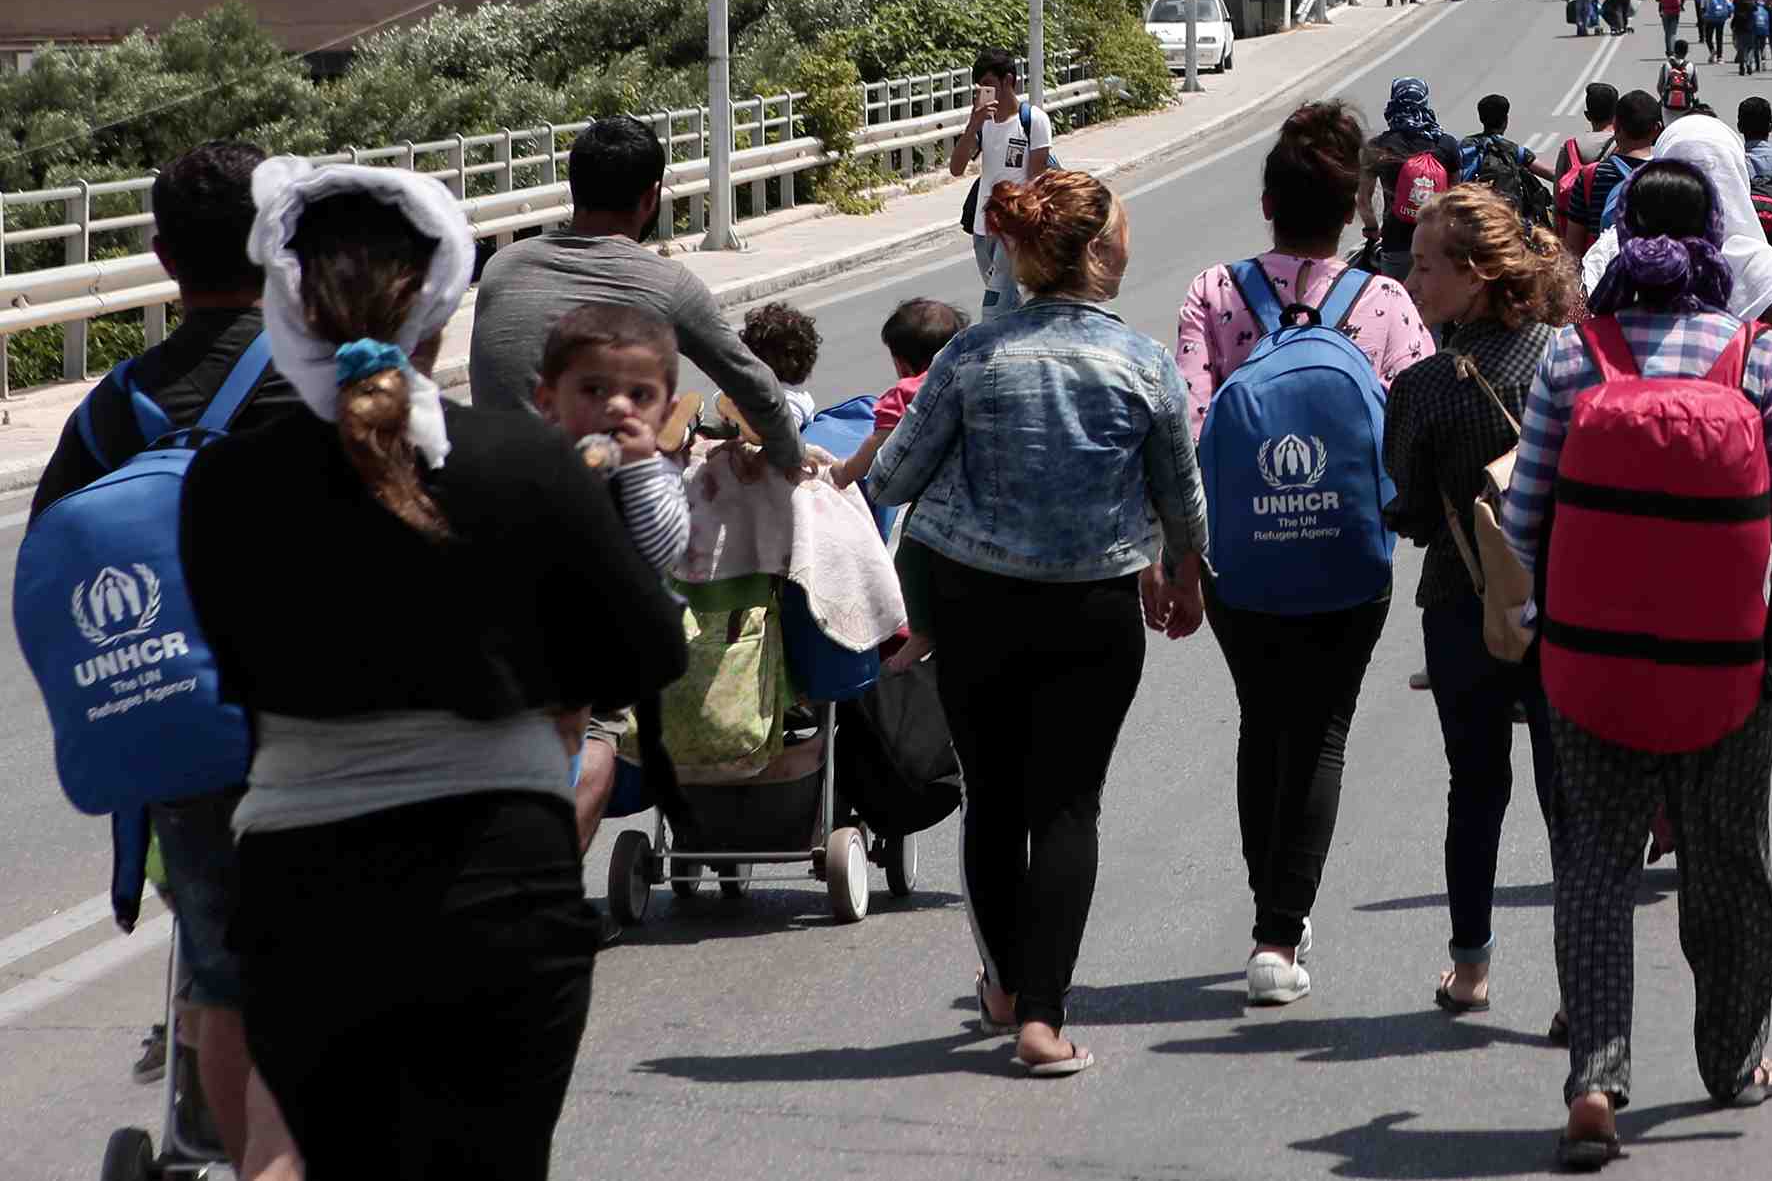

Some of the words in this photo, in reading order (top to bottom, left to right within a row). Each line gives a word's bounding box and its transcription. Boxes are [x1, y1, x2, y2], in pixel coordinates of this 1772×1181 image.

[1252, 491, 1340, 515] UNHCR
[1278, 518, 1298, 528] The
[1300, 515, 1317, 526] UN
[1253, 531, 1299, 541] Refugee
[1301, 528, 1341, 539] Agency
[73, 631, 189, 687] UNHCR
[110, 679, 138, 695] The
[138, 668, 162, 686] UN
[87, 694, 143, 722] Refugee
[143, 677, 198, 702] Agency
